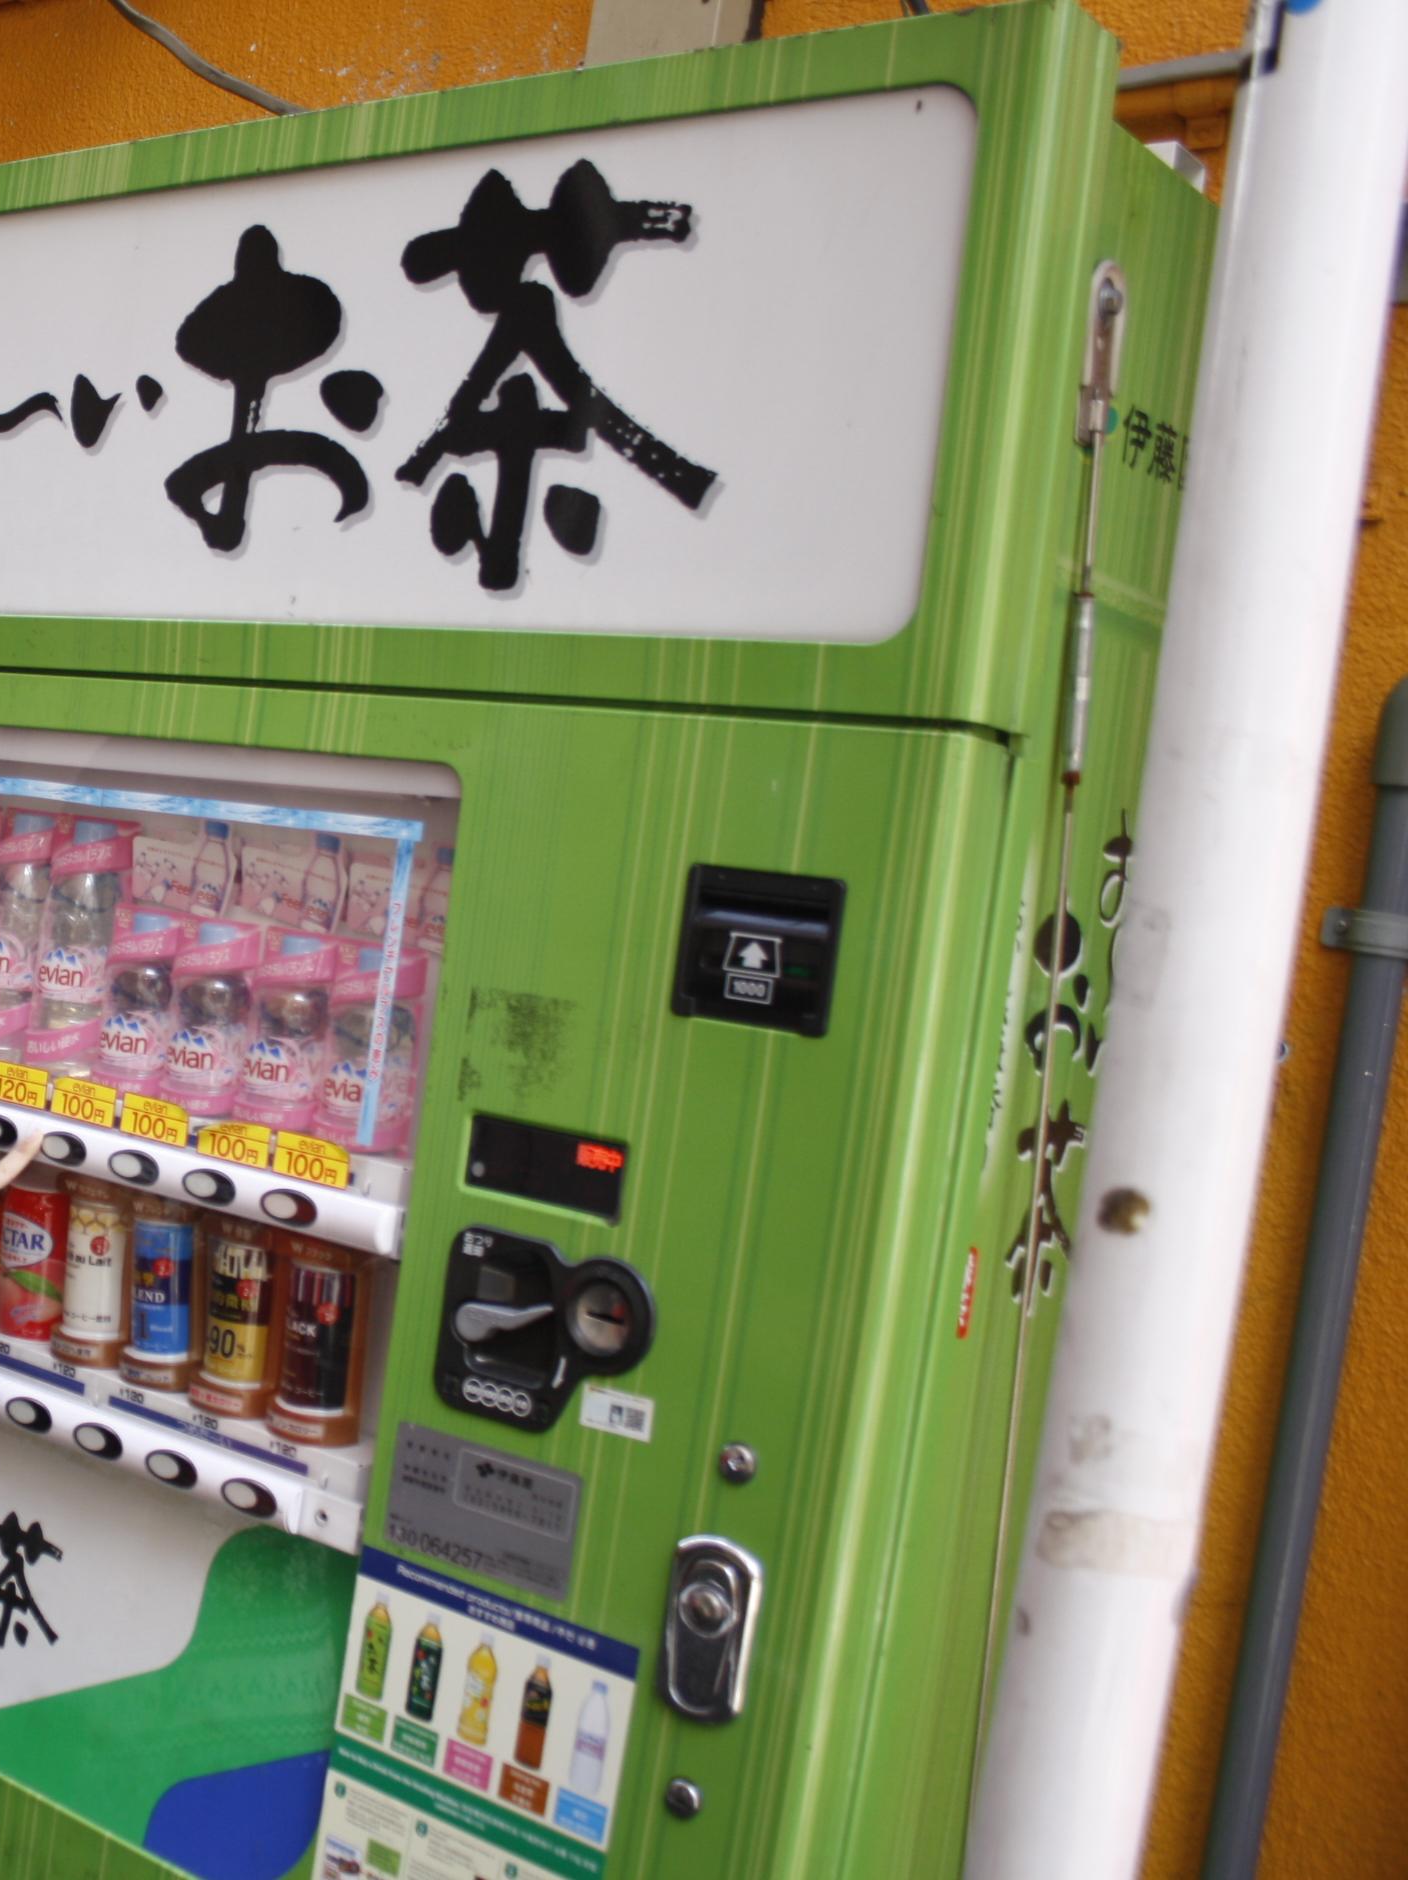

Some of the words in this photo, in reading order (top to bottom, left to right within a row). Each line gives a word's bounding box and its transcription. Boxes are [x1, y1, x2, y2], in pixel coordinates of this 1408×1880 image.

[39, 961, 84, 988] evian
[98, 1030, 148, 1056] evian
[166, 1047, 214, 1071] evian
[324, 1074, 363, 1102] evia
[62, 1093, 105, 1124] 100円
[132, 1111, 178, 1144] 100円
[209, 1132, 259, 1164] 100円
[287, 1151, 338, 1186] 100円
[3, 1229, 45, 1251] CTAR
[133, 1290, 166, 1304] LEND
[208, 1324, 236, 1360] 90
